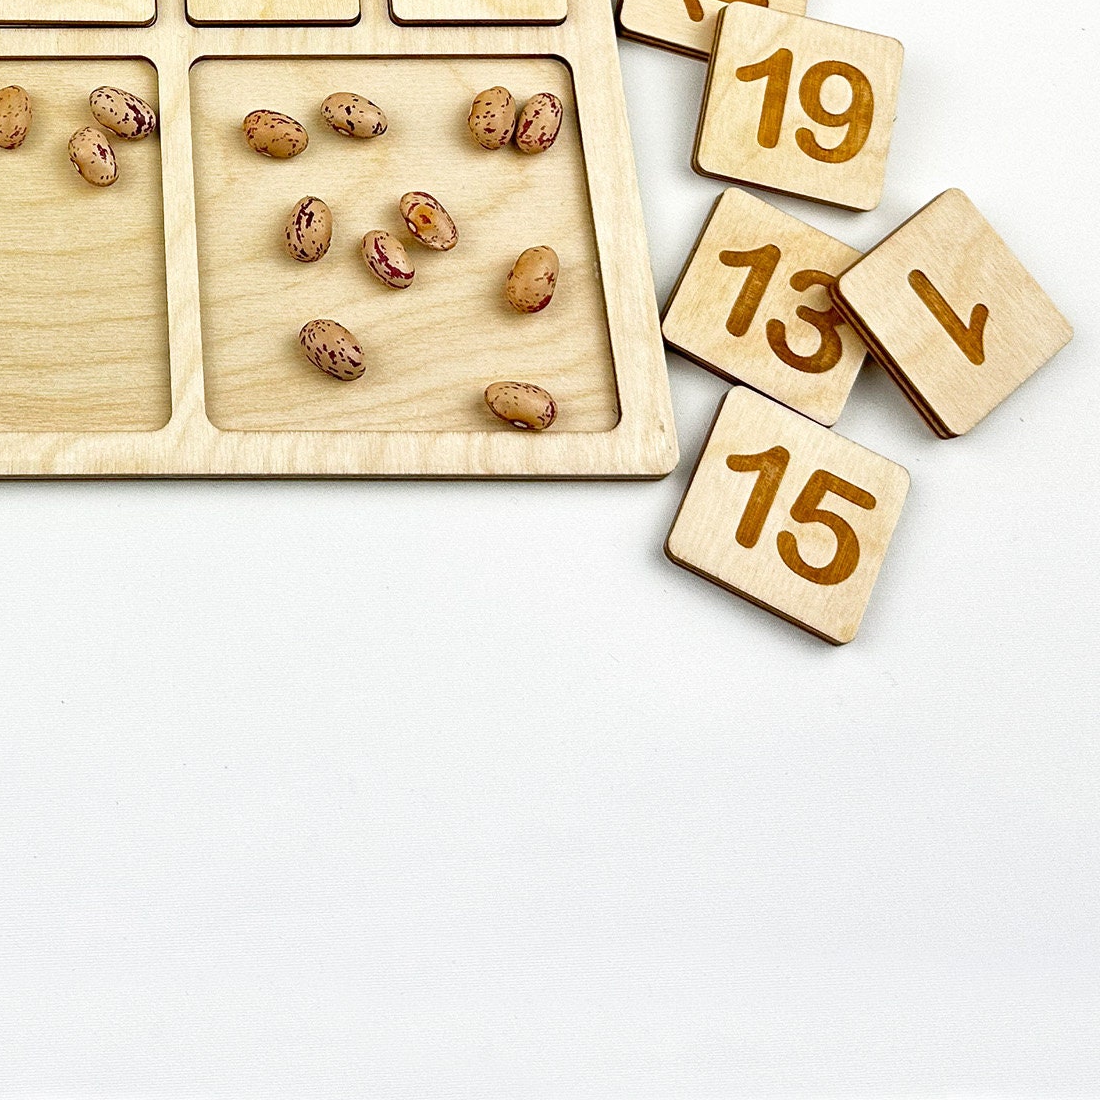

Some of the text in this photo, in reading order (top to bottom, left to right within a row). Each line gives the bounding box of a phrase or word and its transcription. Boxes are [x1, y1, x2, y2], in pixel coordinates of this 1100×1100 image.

[736, 48, 875, 163] 19
[719, 243, 844, 374] 13
[909, 269, 989, 366] 1
[727, 445, 877, 586] 15
